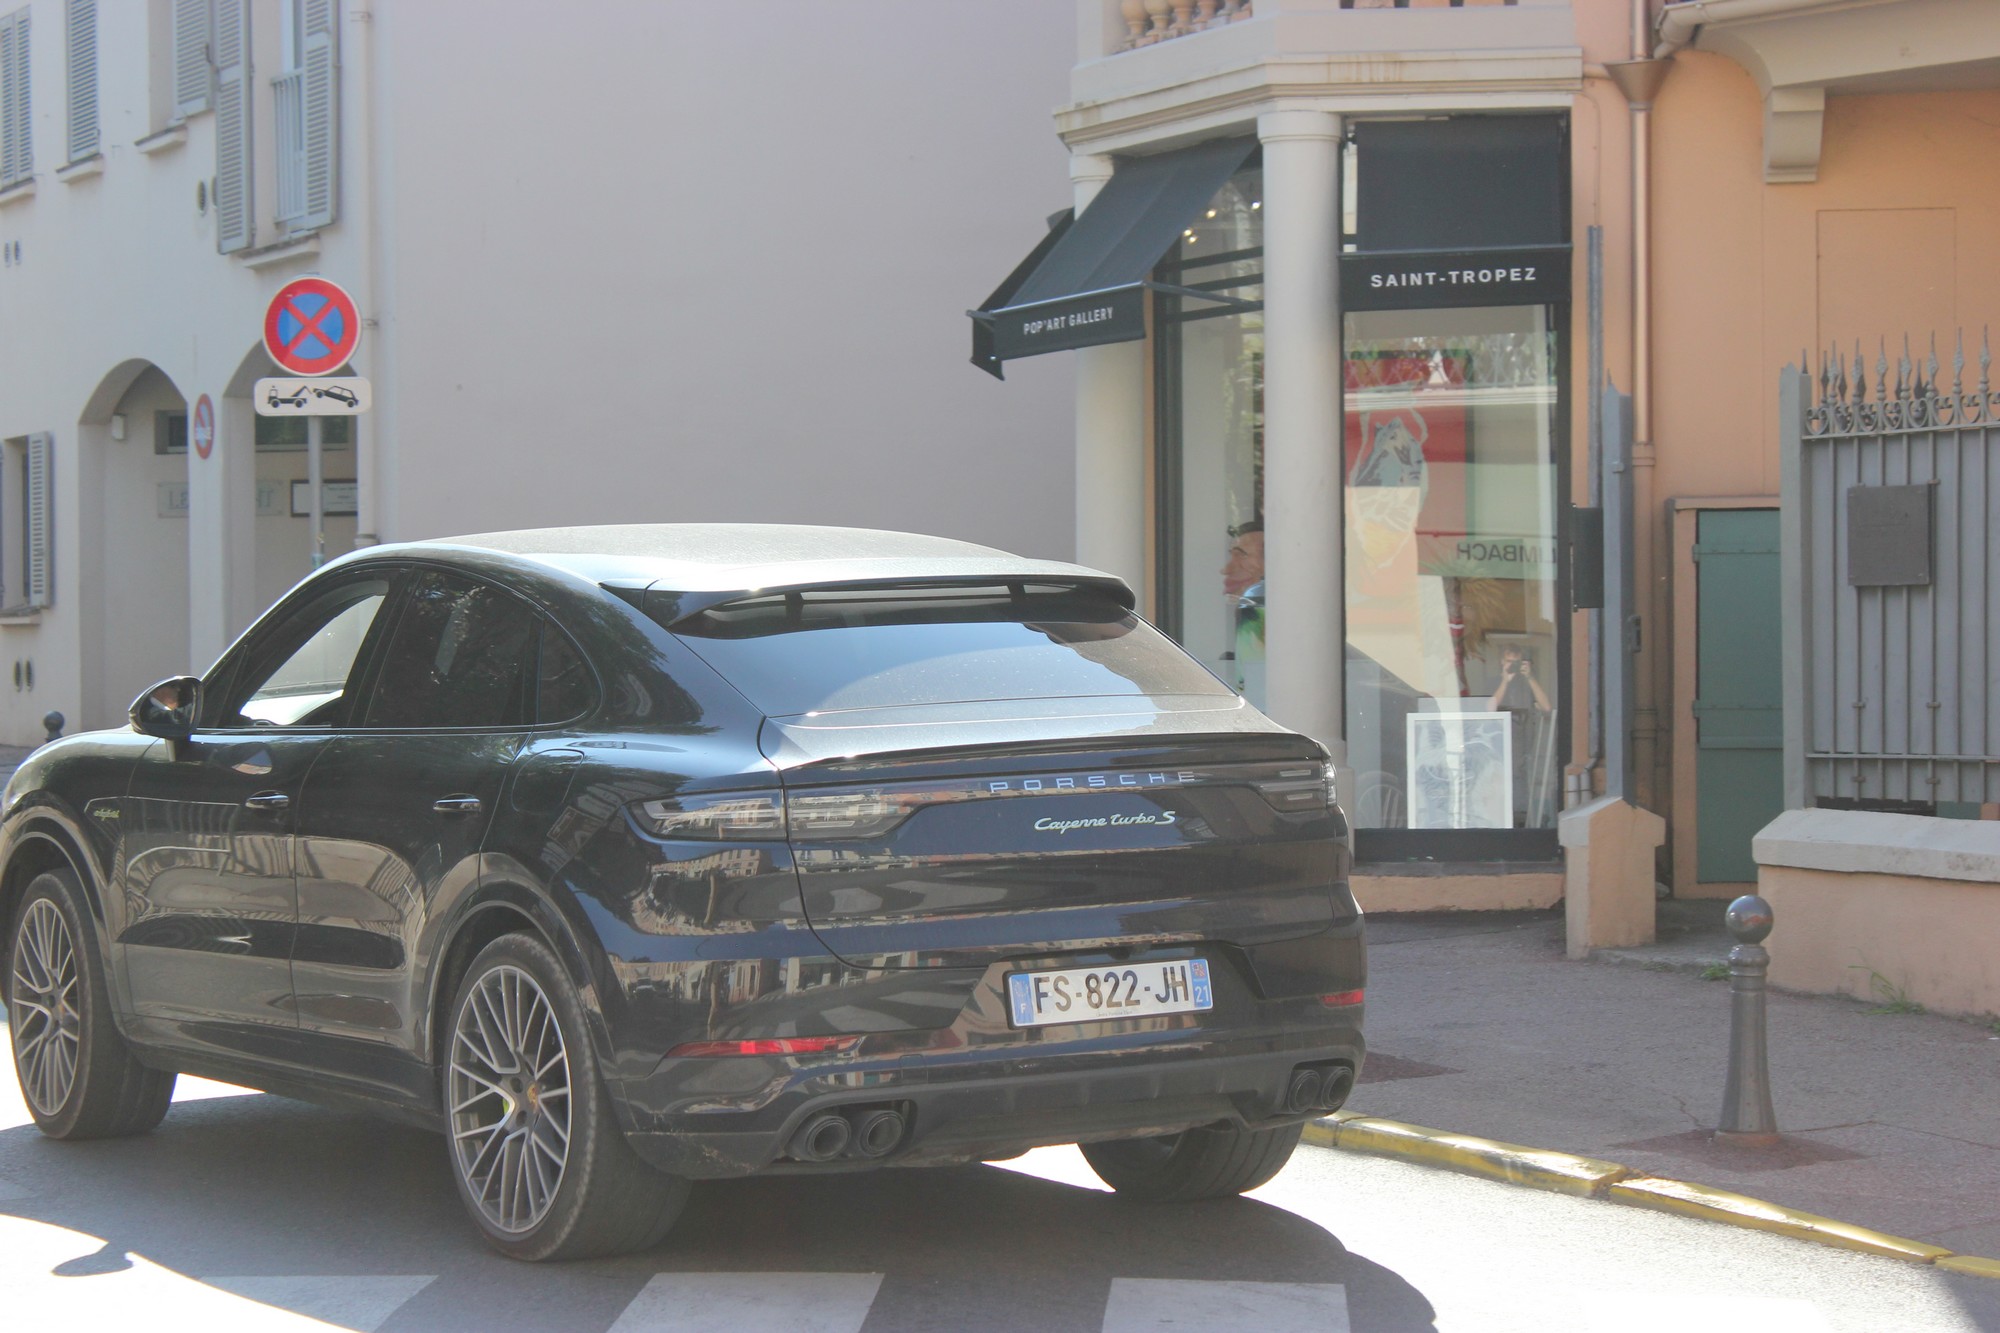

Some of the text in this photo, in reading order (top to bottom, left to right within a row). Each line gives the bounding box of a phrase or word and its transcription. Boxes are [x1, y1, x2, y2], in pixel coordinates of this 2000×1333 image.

[1371, 267, 1536, 288] SAINT-TROPEZ
[1023, 306, 1113, 335] POP'ART GALLERY
[990, 771, 1195, 794] PORSCHE
[1034, 817, 1107, 834] Cayenne
[1155, 810, 1176, 825] S
[1033, 965, 1190, 1014] FS-822-JH
[1194, 985, 1209, 1003] 21
[1020, 1003, 1027, 1014] F
